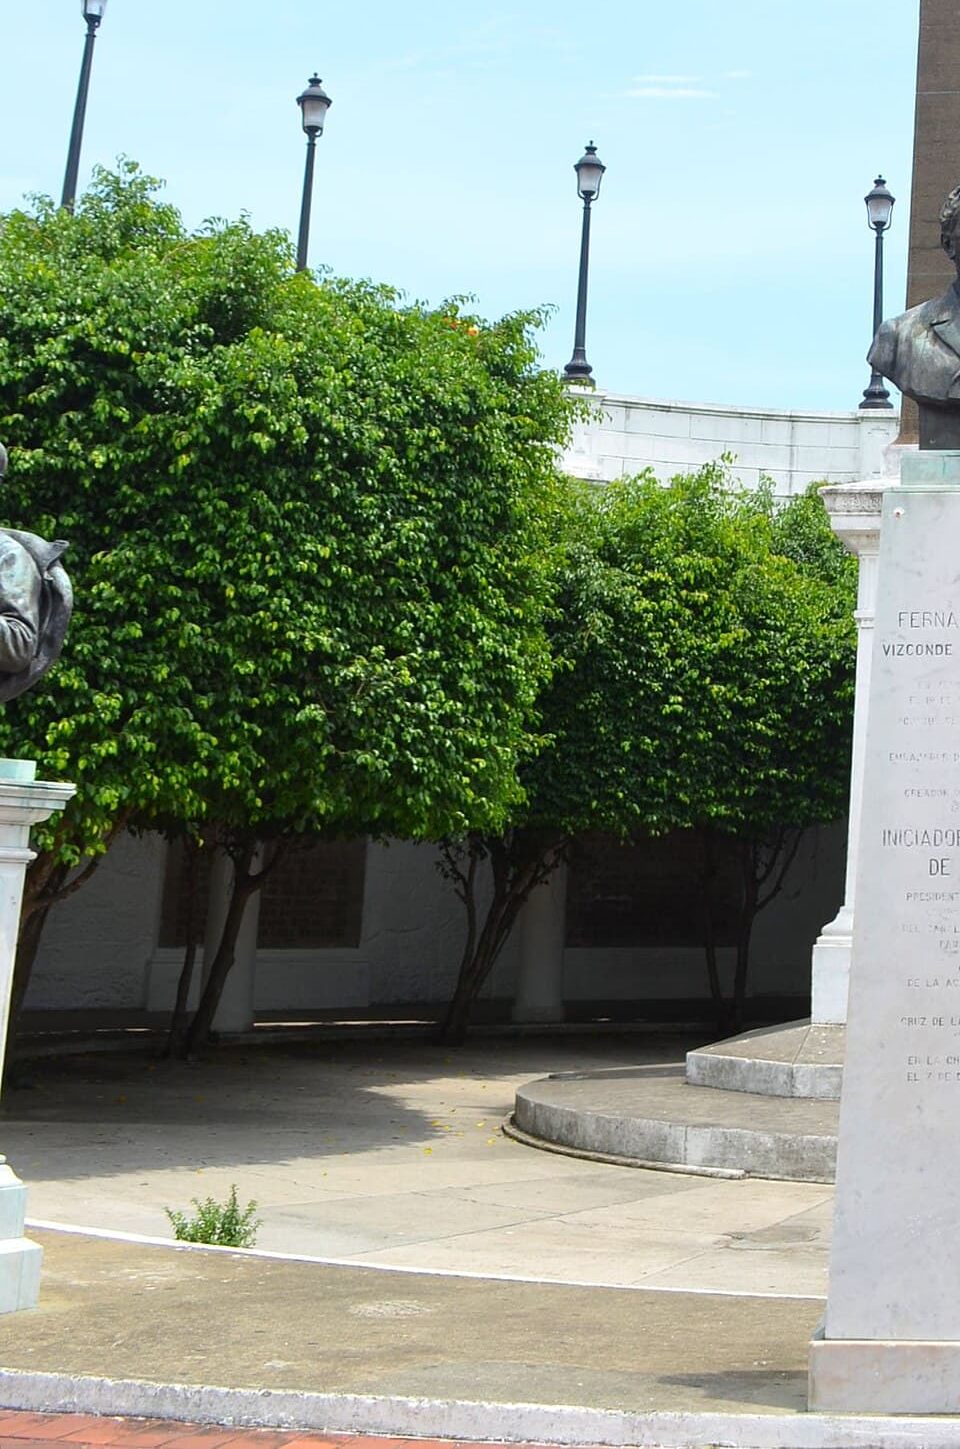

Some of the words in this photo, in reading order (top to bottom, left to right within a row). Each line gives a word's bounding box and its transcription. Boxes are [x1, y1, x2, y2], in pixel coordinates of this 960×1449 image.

[881, 642, 952, 656] VIZCONDE
[929, 858, 951, 876] DE
[932, 1016, 945, 1026] DE
